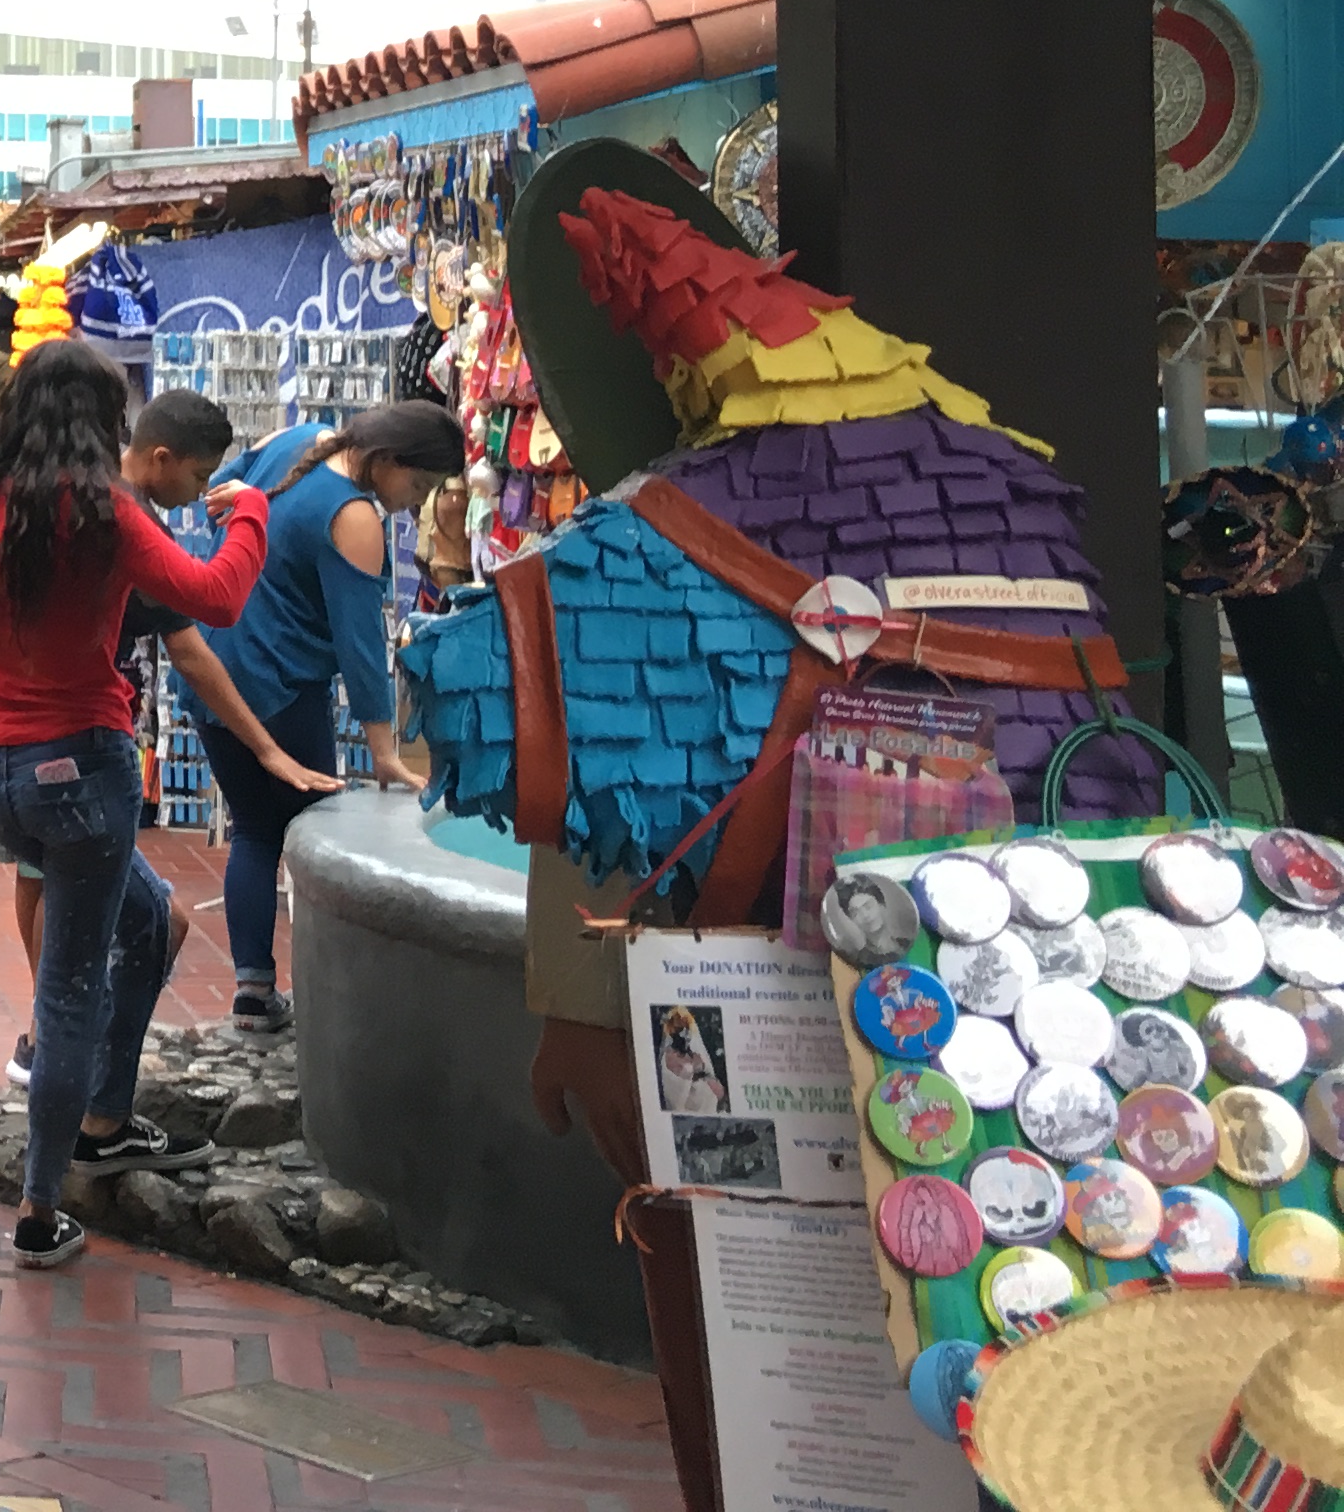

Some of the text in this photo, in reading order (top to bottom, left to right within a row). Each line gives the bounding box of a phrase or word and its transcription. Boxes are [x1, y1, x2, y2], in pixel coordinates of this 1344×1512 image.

[661, 960, 695, 975] Your
[699, 960, 784, 975] DONATION
[677, 986, 750, 1000] traditional
